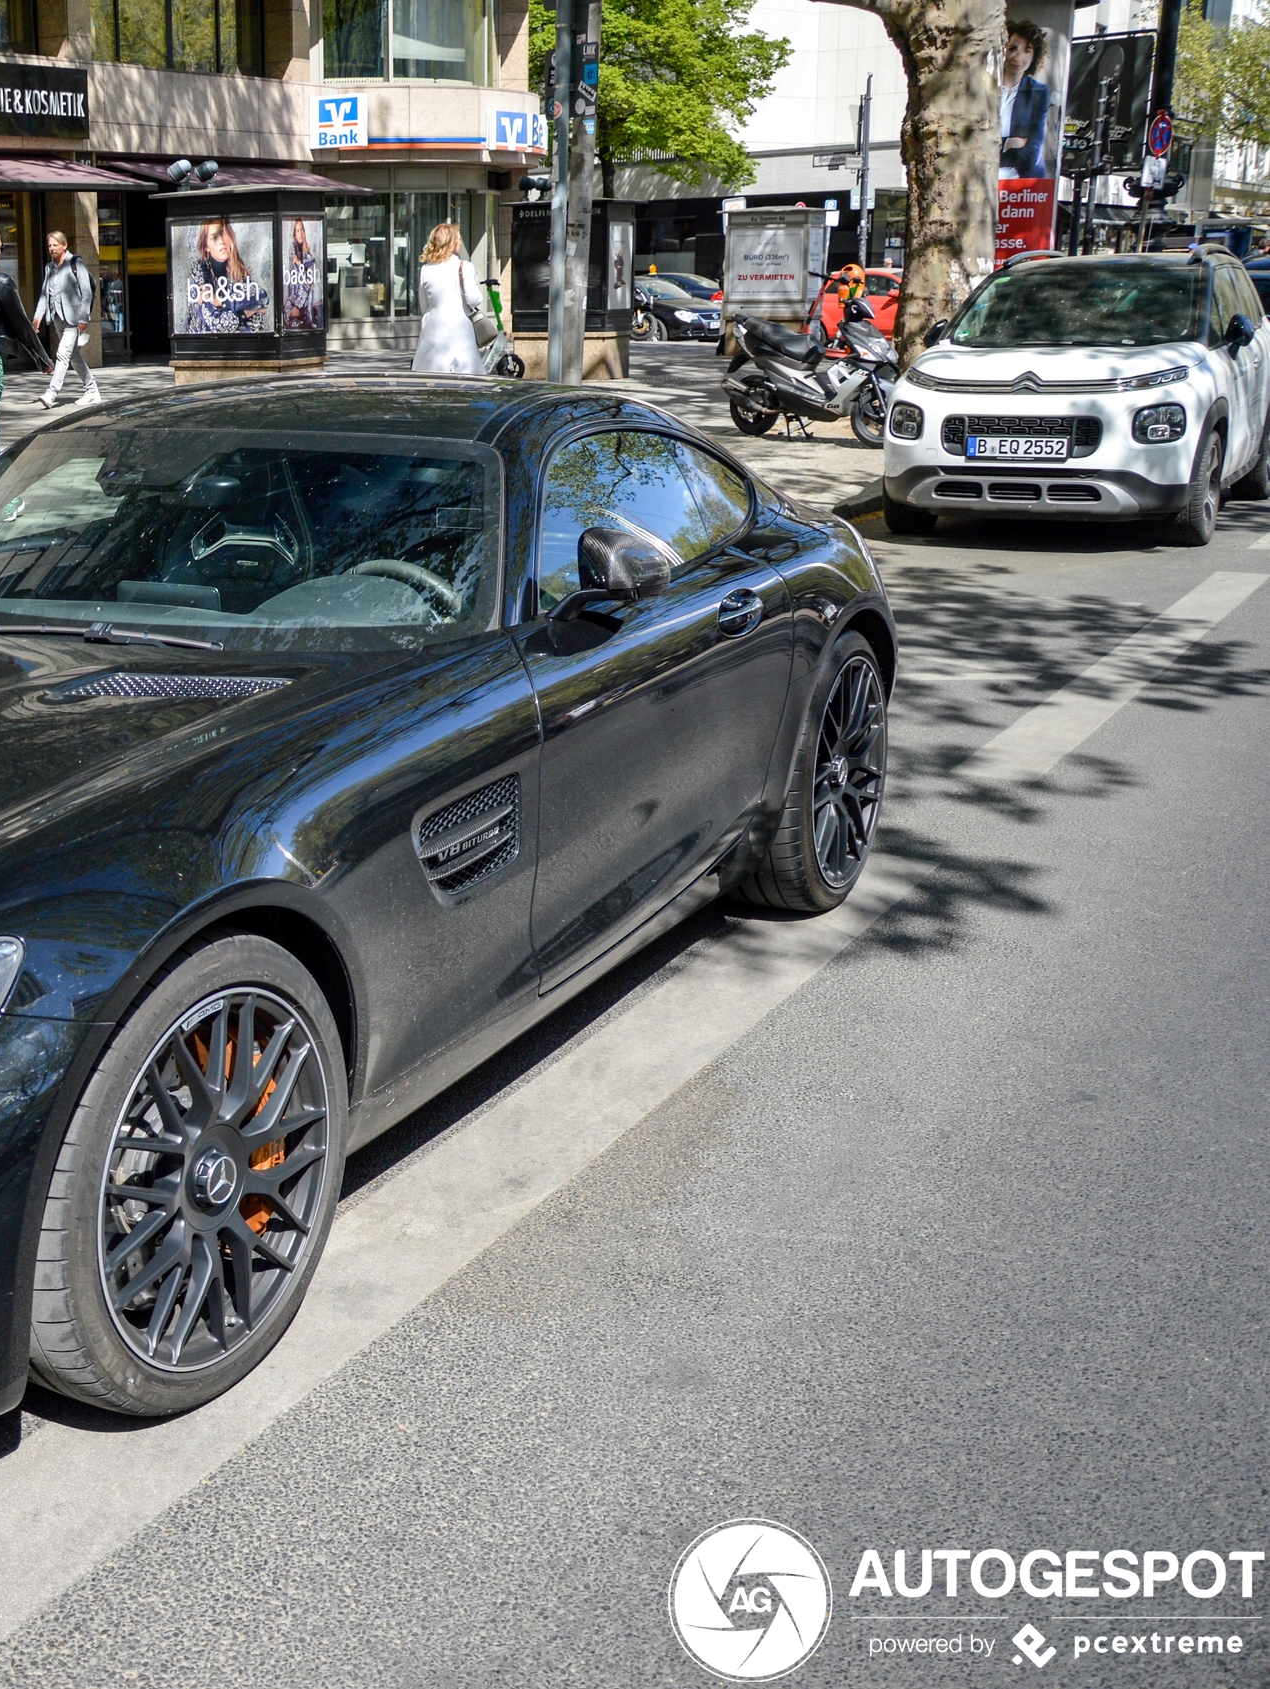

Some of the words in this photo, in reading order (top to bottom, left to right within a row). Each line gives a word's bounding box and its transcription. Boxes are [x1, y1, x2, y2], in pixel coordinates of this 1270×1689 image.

[318, 128, 358, 146] Bank
[999, 189, 1048, 203] Berliner
[525, 209, 545, 218] DELFI
[1001, 205, 1035, 218] dann
[995, 223, 1009, 233] er
[994, 238, 1027, 248] asse.
[283, 264, 320, 285] ba&sh
[187, 276, 259, 303] ba&sh
[977, 439, 987, 454] B
[998, 439, 1020, 455] EQ
[1023, 440, 1065, 455] 2552
[437, 843, 461, 862] V8
